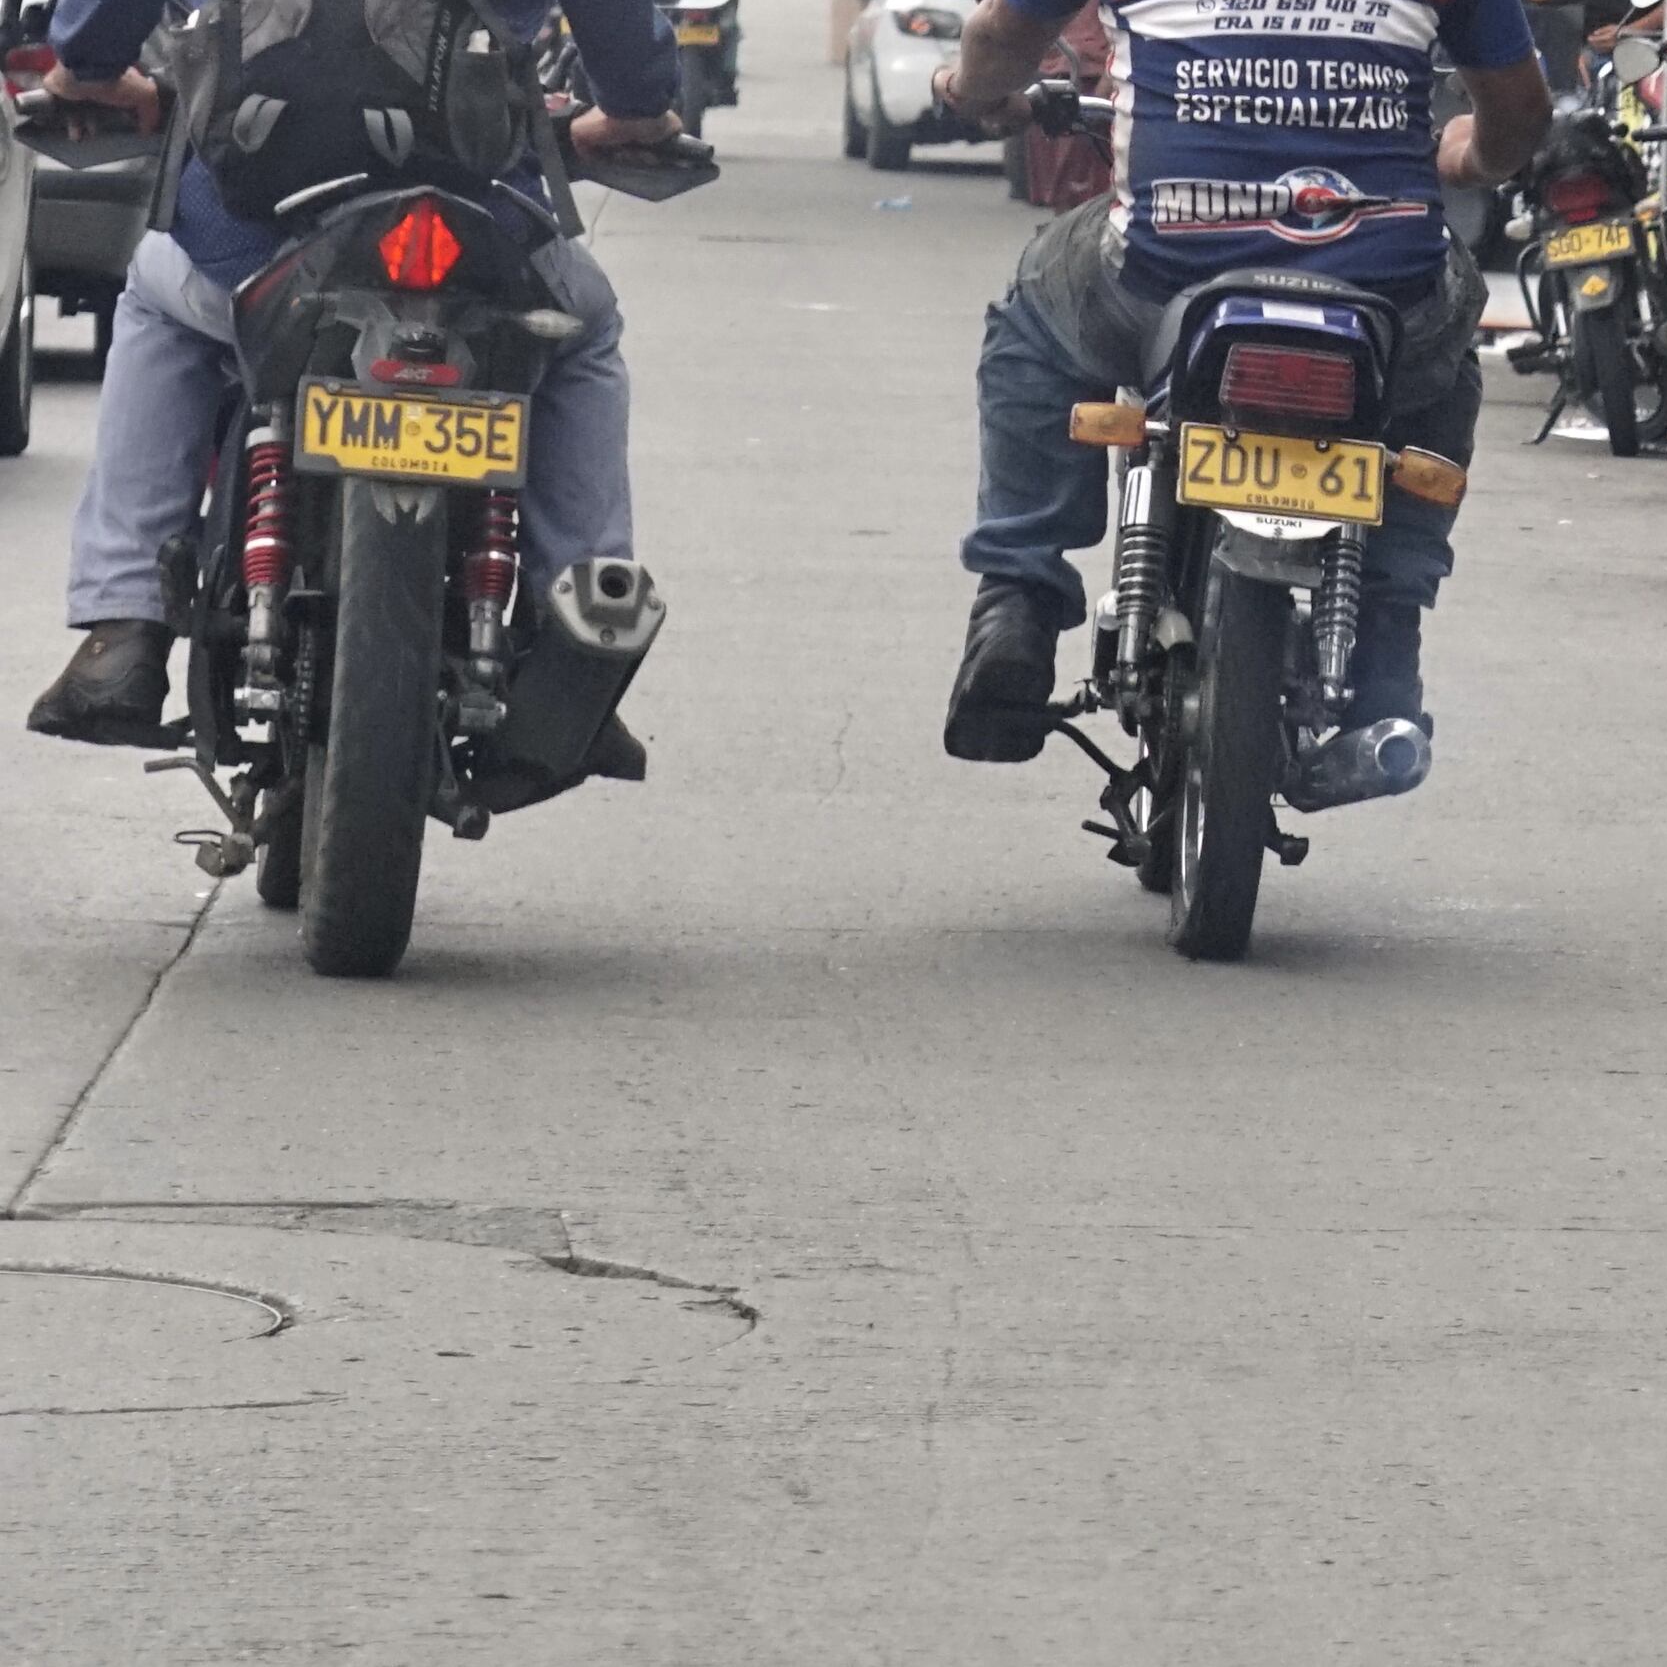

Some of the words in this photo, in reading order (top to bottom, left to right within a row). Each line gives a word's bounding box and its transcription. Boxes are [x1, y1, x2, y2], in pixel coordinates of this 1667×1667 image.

[1175, 57, 1299, 91] SERVICIO
[1306, 59, 1410, 95] TECNICO
[1173, 92, 1410, 131] ESPECIALIZADO
[312, 397, 402, 451] YMM
[423, 406, 516, 462] 35E
[1255, 516, 1303, 529] SUZUKI
